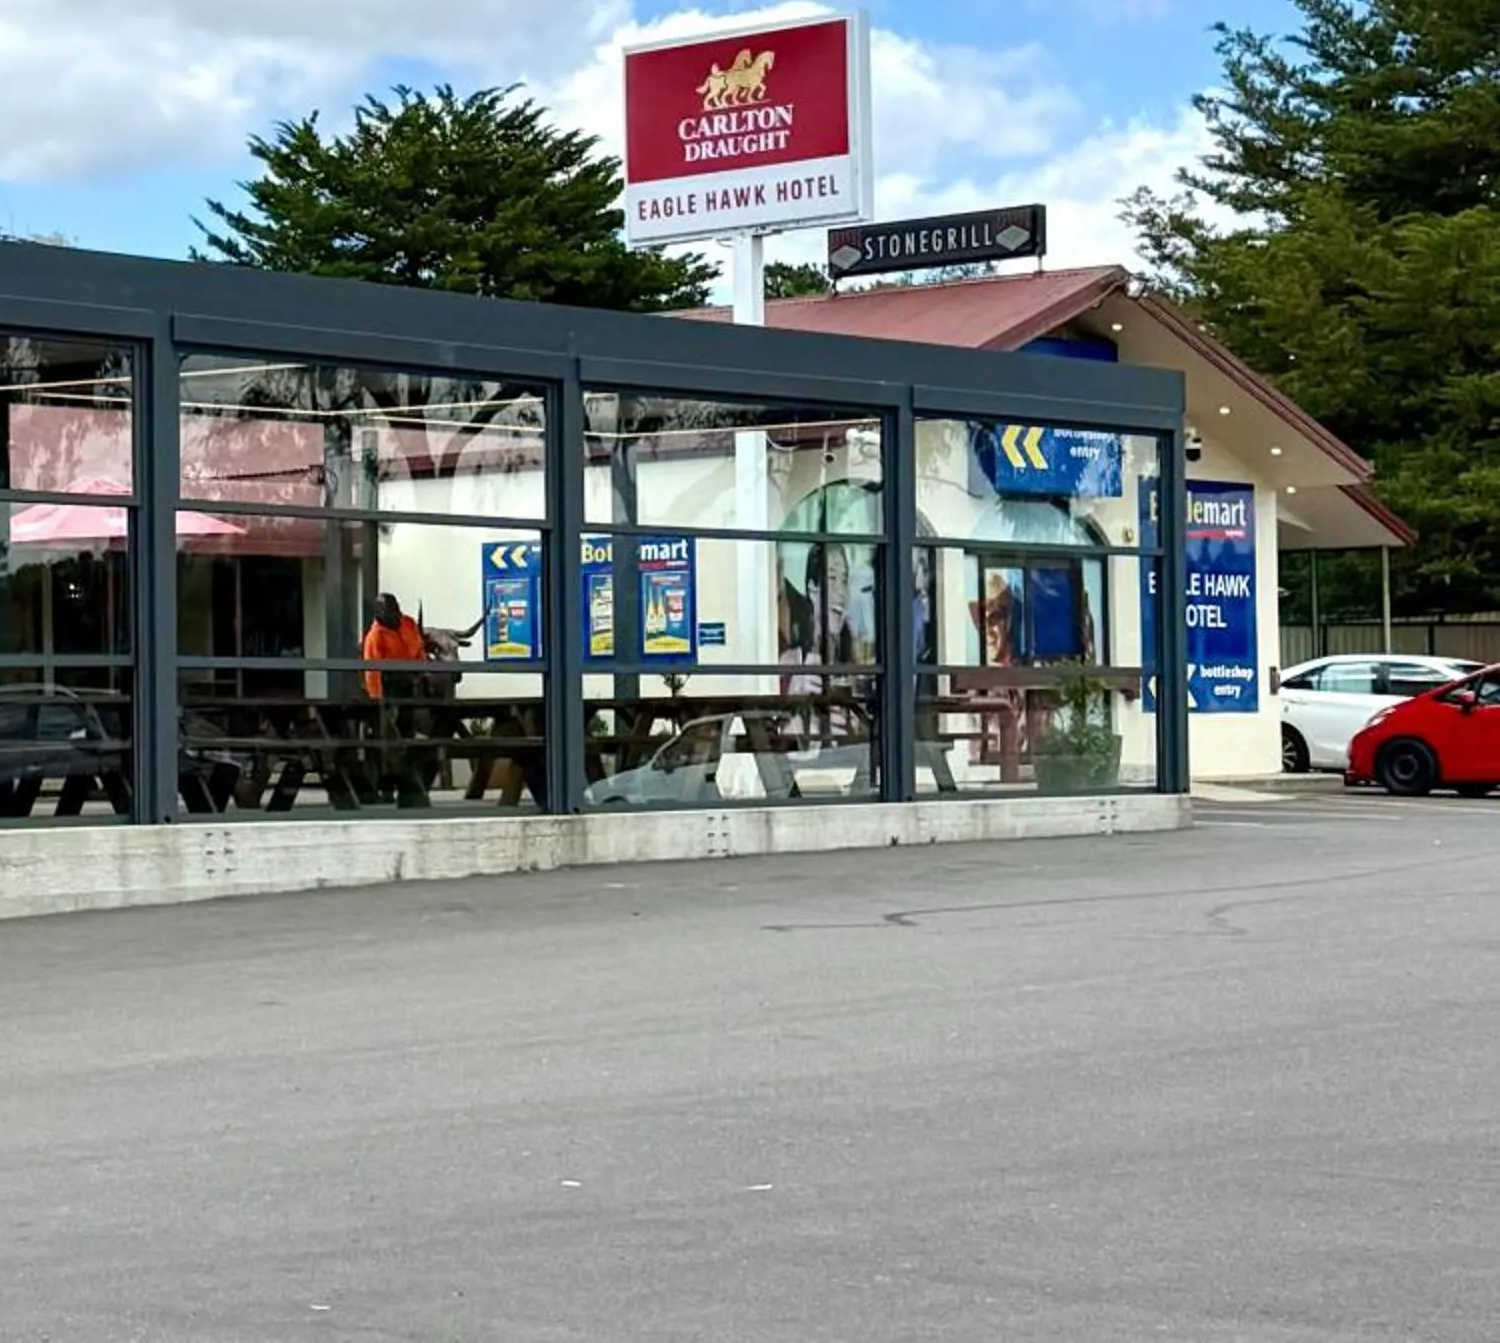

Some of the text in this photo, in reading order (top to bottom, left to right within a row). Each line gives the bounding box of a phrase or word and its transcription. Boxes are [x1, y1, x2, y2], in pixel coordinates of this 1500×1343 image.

[678, 105, 794, 140] CARLTON
[685, 130, 790, 161] DRAUGHT
[638, 175, 839, 221] EAGLE HAWK HOTEL
[865, 223, 992, 260] STONEGRILL
[1205, 573, 1250, 597] HAWK
[1185, 604, 1227, 628] OTEL
